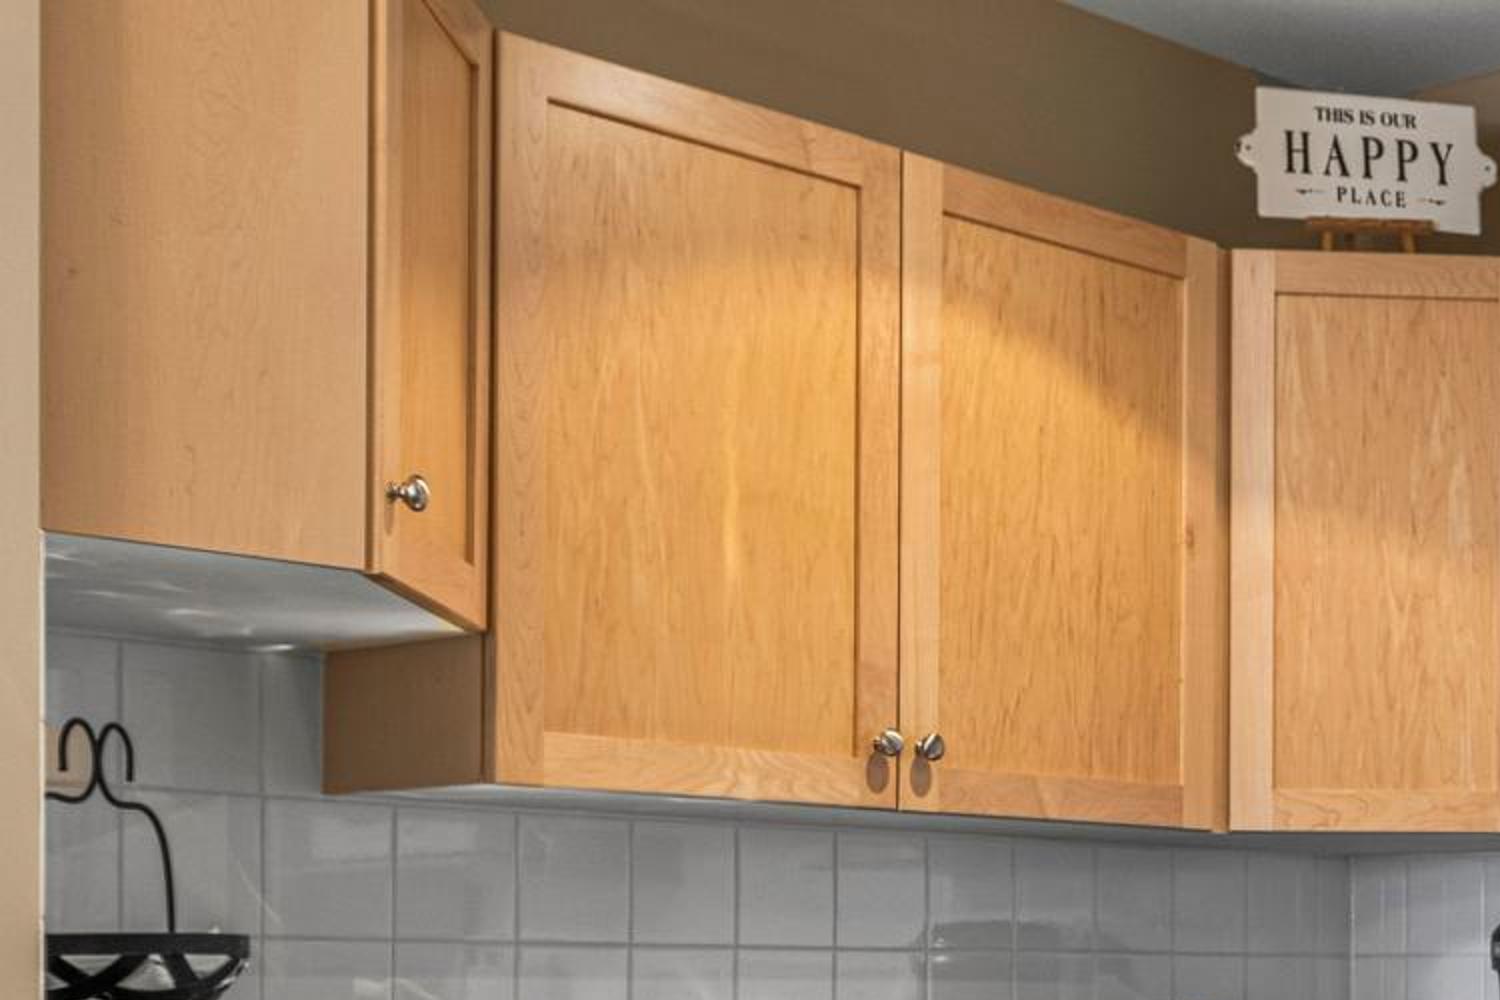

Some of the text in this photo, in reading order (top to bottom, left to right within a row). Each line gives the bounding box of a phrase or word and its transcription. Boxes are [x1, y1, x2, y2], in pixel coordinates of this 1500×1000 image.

[1314, 107, 1417, 129] THIS IS OUR
[1284, 130, 1453, 185] HAPPY
[1337, 186, 1407, 208] PLACE
